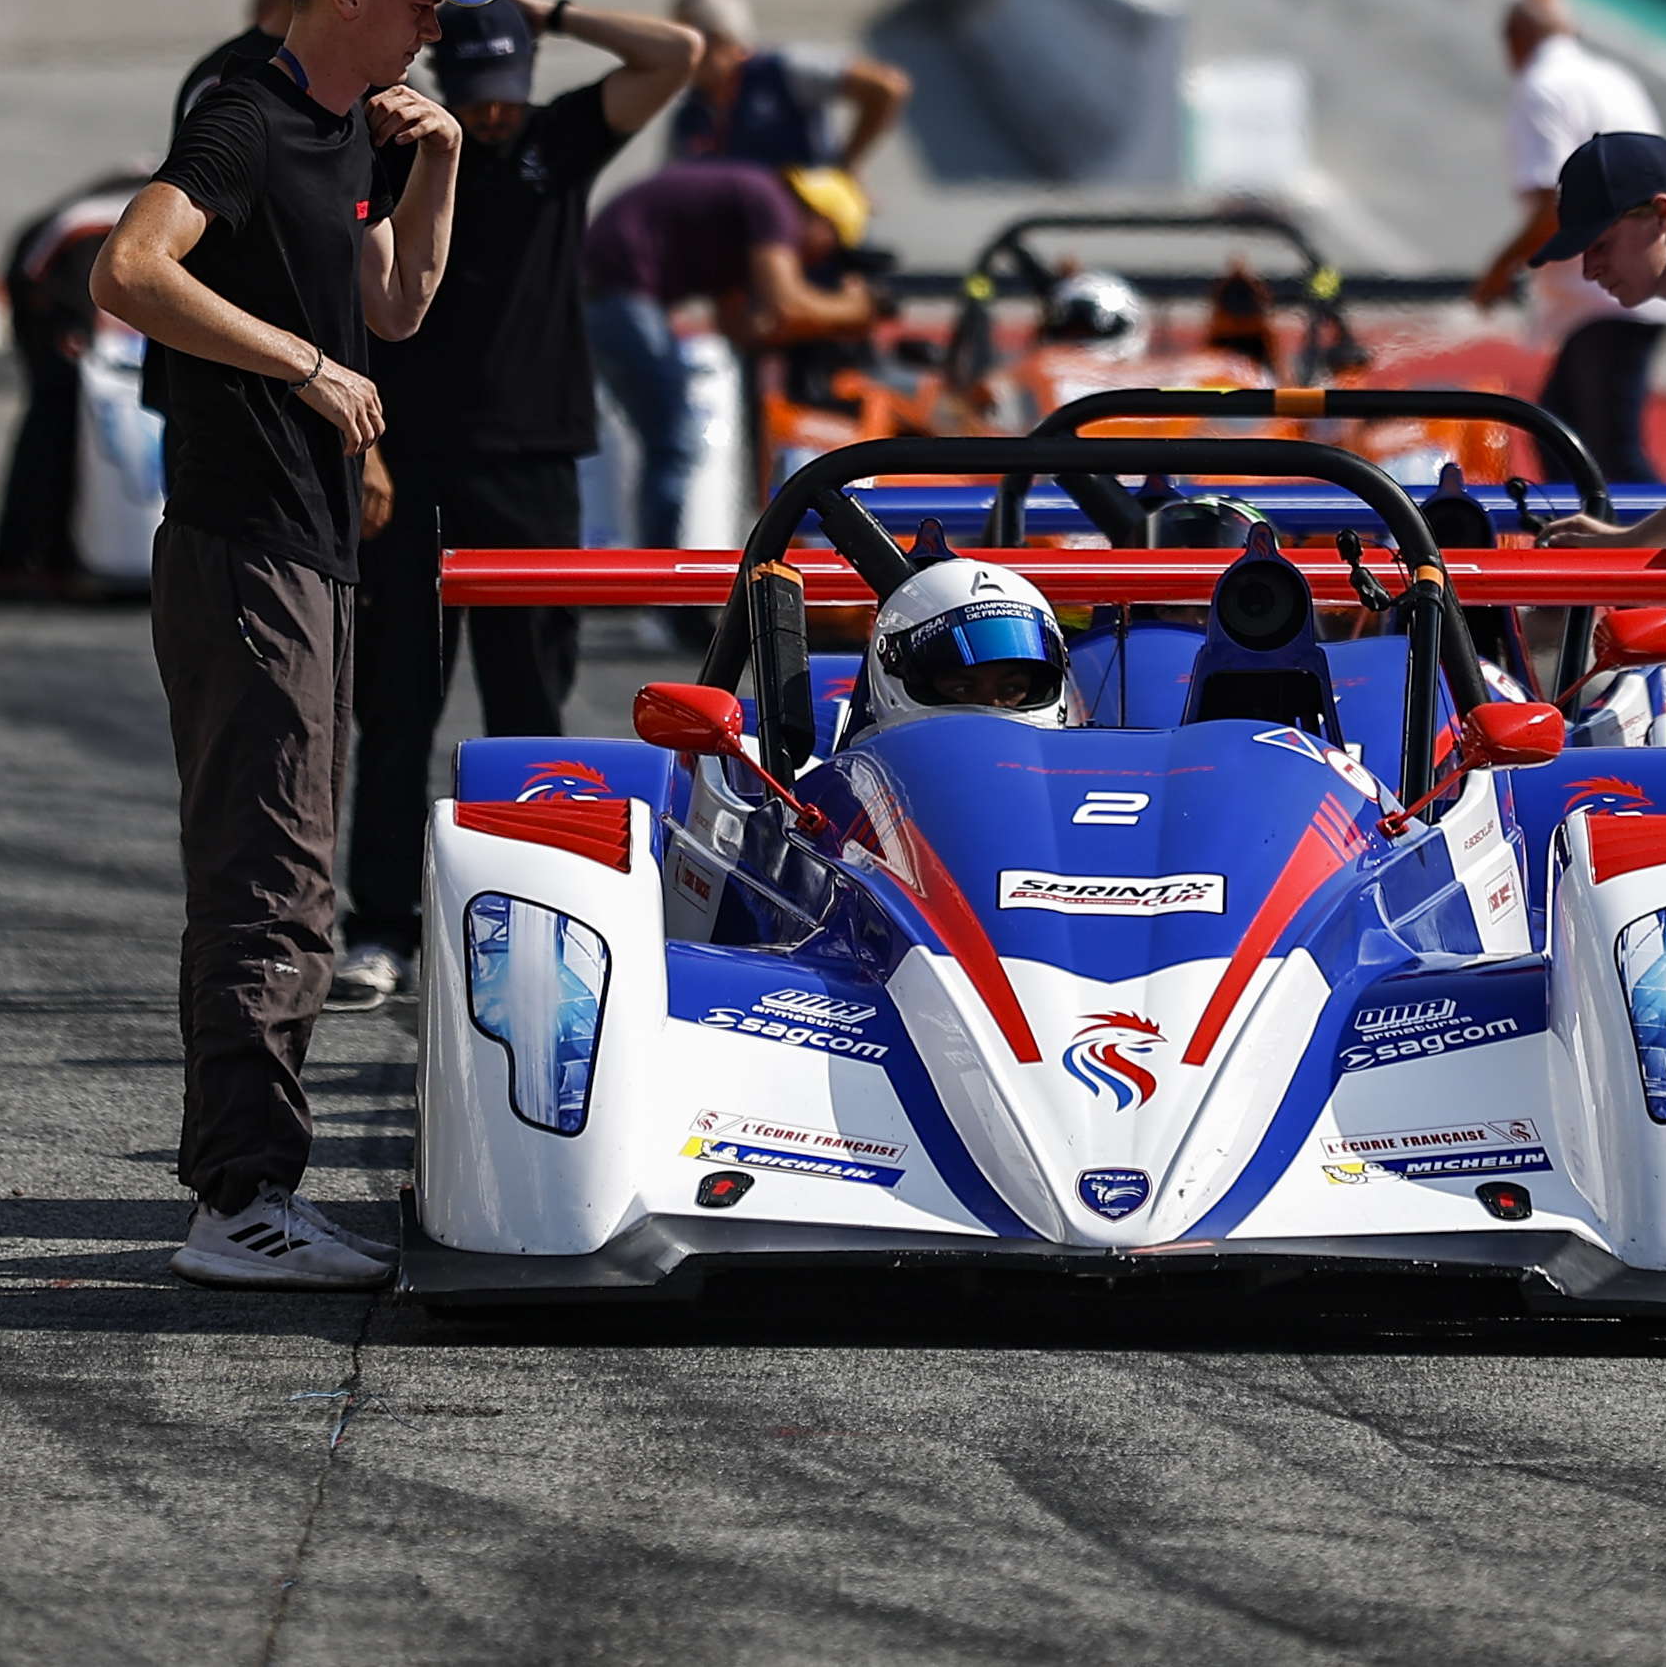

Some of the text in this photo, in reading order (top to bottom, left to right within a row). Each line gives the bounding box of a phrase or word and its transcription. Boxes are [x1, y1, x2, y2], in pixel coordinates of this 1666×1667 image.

[964, 601, 1032, 615] CHAMPIONNAT
[966, 612, 981, 621] DE
[982, 609, 1023, 618] FRANCE
[1071, 791, 1150, 825] 2
[1016, 880, 1183, 897] SPRINT
[1141, 893, 1205, 907] CUP
[751, 1004, 864, 1035] armatures
[1362, 1016, 1473, 1042] armatures
[737, 1017, 889, 1059] sagcom
[1376, 1018, 1519, 1061] sagcom
[741, 1123, 900, 1159] L'ÉCURIE FRANÇAISE
[1328, 1129, 1488, 1154] L'ÉCURIE FRANÇAISE
[743, 1153, 877, 1180] MICHELIN
[1405, 1153, 1545, 1173] MICHELIN
